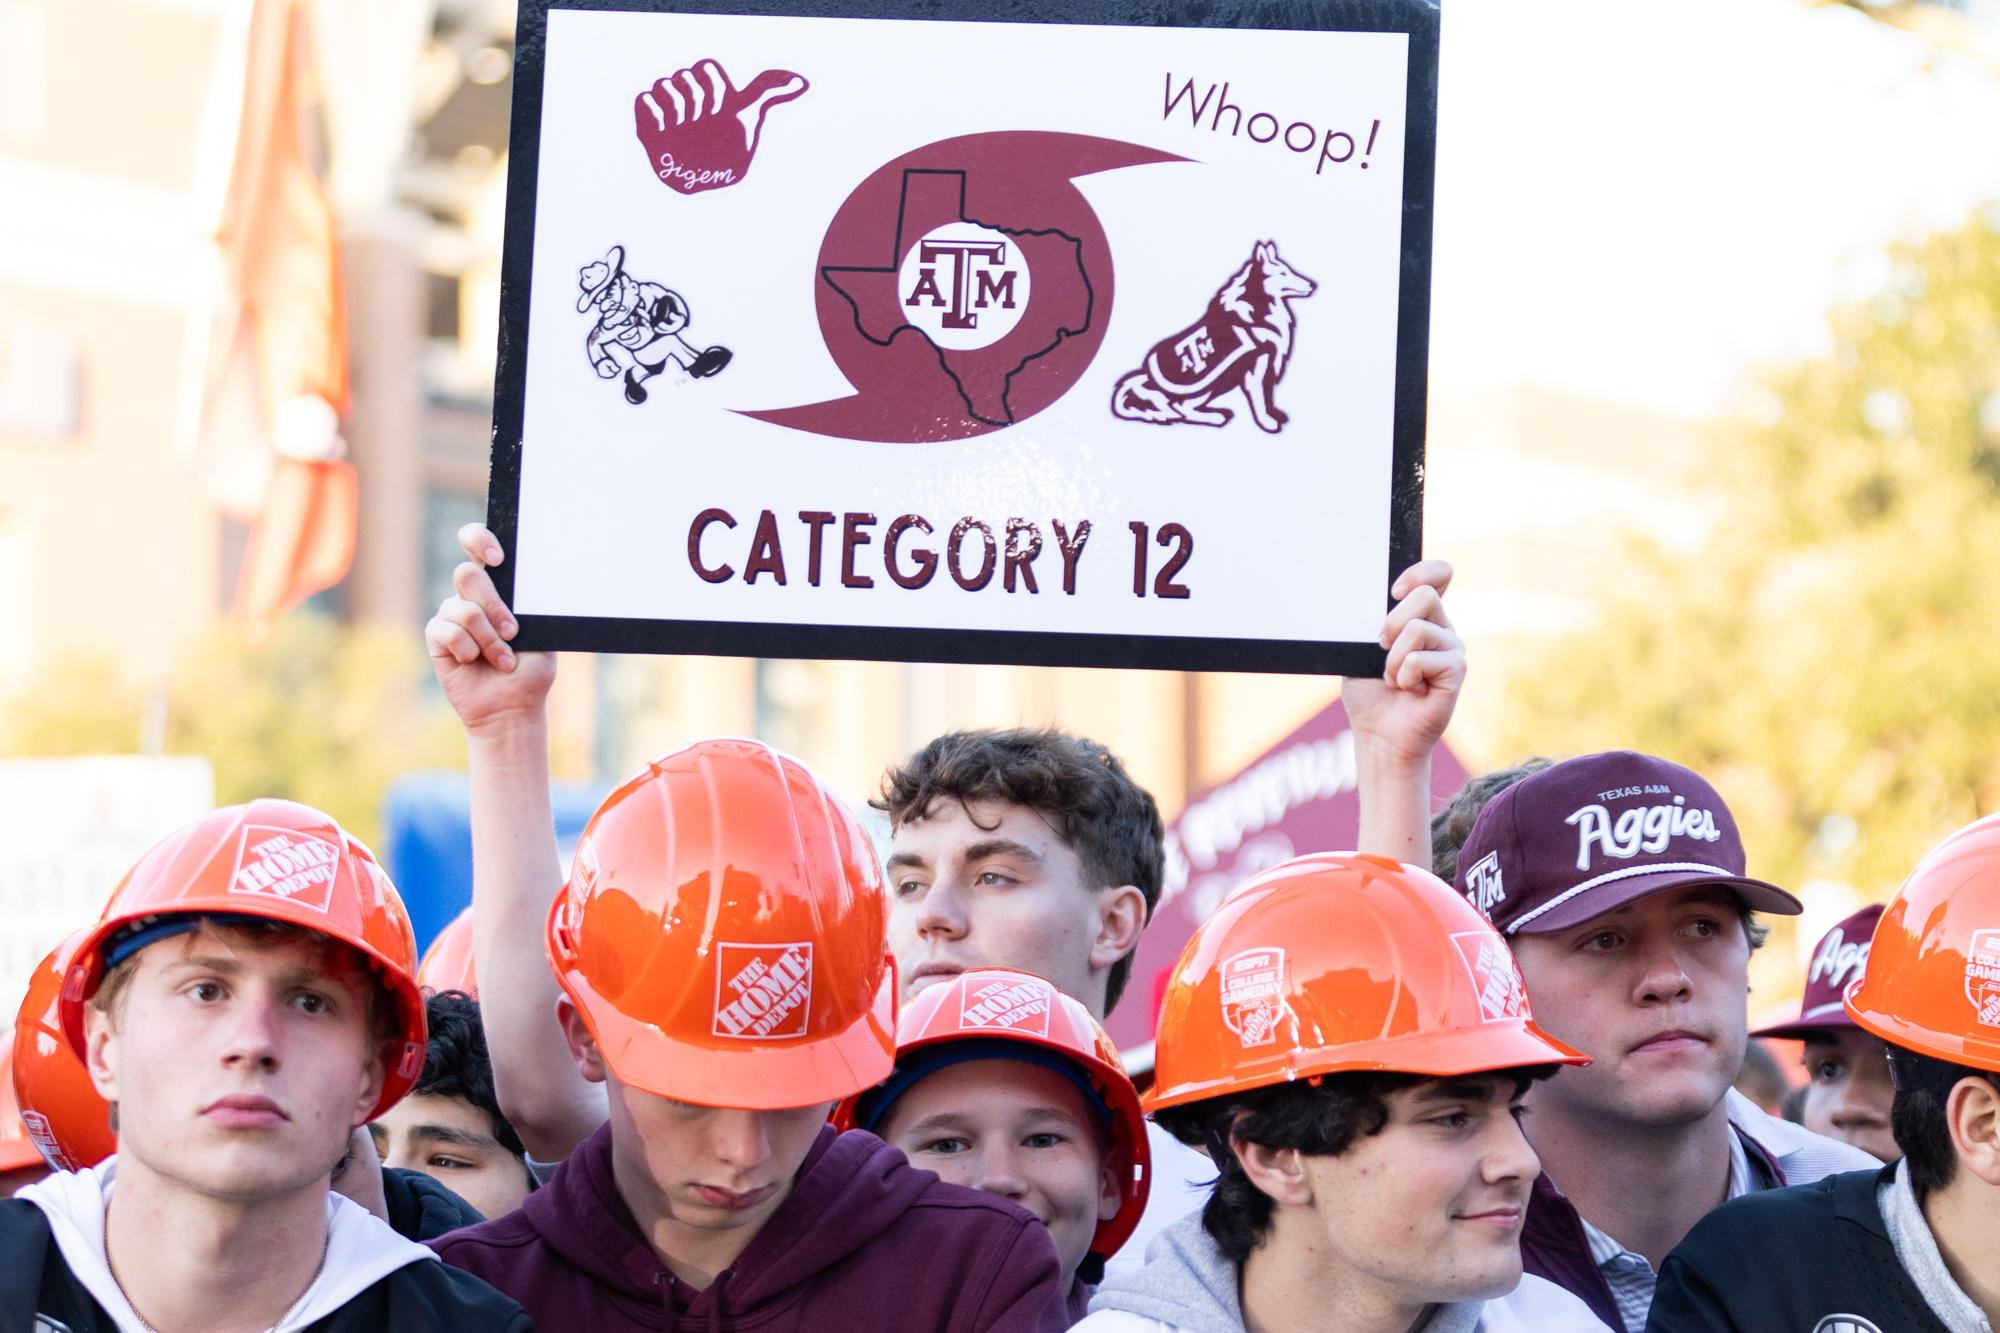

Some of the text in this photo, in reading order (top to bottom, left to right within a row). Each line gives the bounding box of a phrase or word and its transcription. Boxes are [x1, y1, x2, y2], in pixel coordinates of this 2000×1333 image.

[1163, 72, 1381, 175] Whoop!
[687, 507, 1194, 599] CATEGORY 12
[1597, 784, 1671, 802] TEXAS A&M
[250, 834, 295, 858] THE
[1564, 795, 1722, 872] Aggies
[237, 838, 338, 893] HOME
[271, 864, 334, 898] DEPOT
[727, 956, 770, 994] THE
[1228, 971, 1276, 991] COLLEGE
[1234, 954, 1271, 974] ESPN
[717, 944, 812, 1036] HOME
[963, 982, 1050, 1027] HOME
[972, 981, 1010, 1000] THE
[1221, 981, 1284, 1006] GAMEDAY
[752, 980, 810, 1037] DEPOT
[995, 999, 1048, 1028] DEPOT
